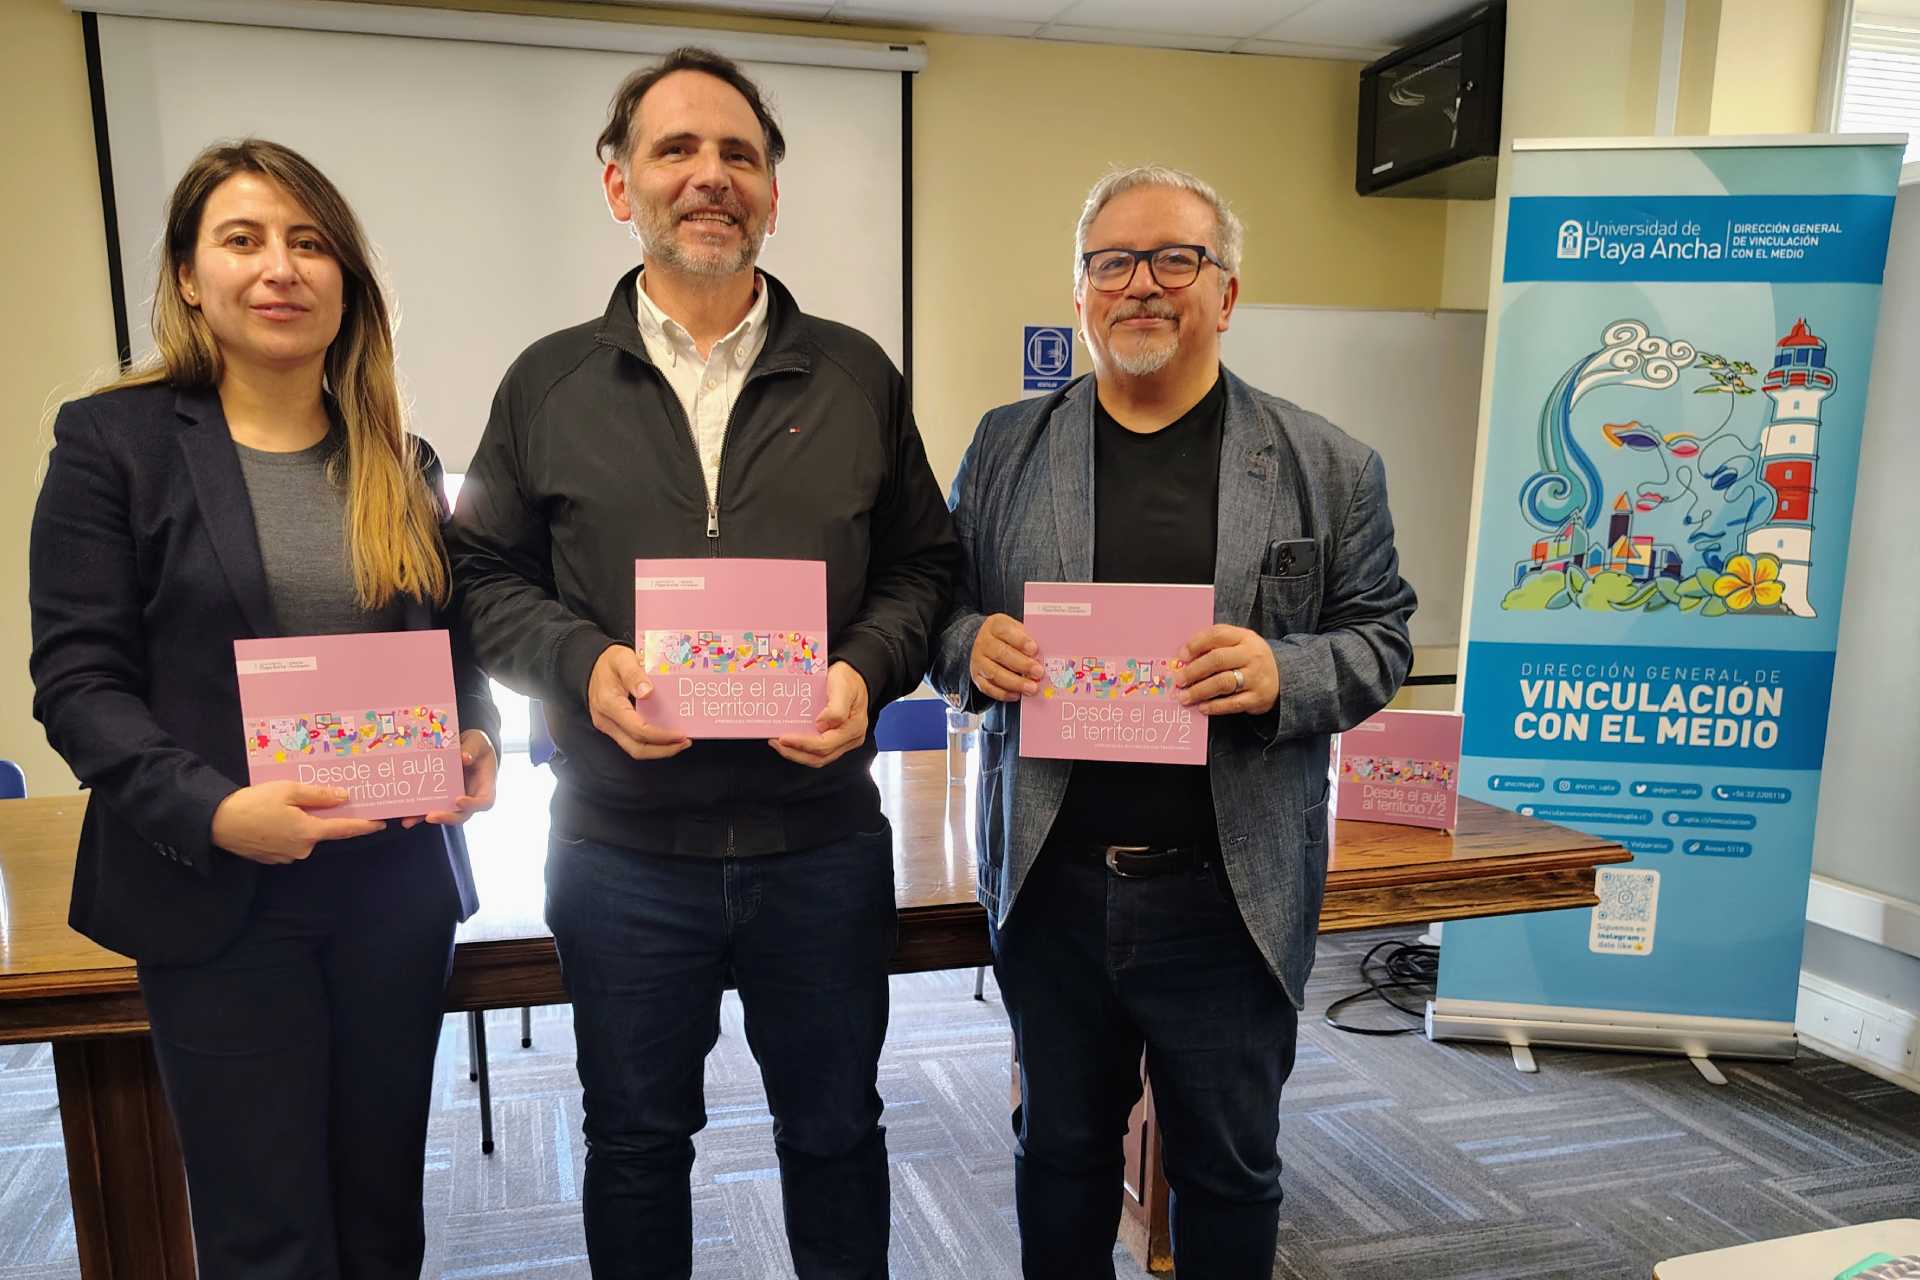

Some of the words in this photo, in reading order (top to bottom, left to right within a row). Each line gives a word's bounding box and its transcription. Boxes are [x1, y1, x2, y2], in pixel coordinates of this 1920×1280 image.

[1586, 220, 1678, 237] Universidad
[1681, 221, 1701, 237] de
[1733, 222, 1790, 235] DIRECCIÓN
[1791, 223, 1842, 234] GENERAL
[1583, 237, 1645, 265] Playa
[1649, 237, 1722, 260] Ancha
[1732, 236, 1747, 247] DE
[1748, 235, 1820, 247] VINCULACIÓN
[1731, 249, 1753, 259] CON
[1755, 249, 1768, 259] EL
[1770, 249, 1805, 259] MEDIO
[1520, 662, 1636, 679] DIRECCIÓN
[1646, 666, 1742, 682] GENERAL
[1754, 670, 1782, 684] DE
[679, 677, 744, 697] Desde
[750, 678, 766, 698] el
[772, 678, 812, 698] aula
[679, 698, 695, 717] al
[702, 699, 778, 718] territorio
[784, 699, 793, 716] /
[799, 699, 812, 717] 2
[1519, 679, 1784, 718] VINCULACIÓN
[1061, 702, 1123, 723] Desde
[1130, 704, 1146, 723] el
[1152, 704, 1192, 725] aula
[1061, 722, 1076, 740] al
[1081, 723, 1157, 743] territorio
[1162, 723, 1173, 743] /
[1178, 725, 1192, 744] 2
[1513, 711, 1590, 742] CON
[1599, 714, 1646, 744] EL
[1655, 715, 1779, 750] MEDIO
[299, 760, 370, 785] Desde
[378, 756, 395, 778] el
[402, 755, 446, 775] aula
[326, 776, 411, 800] rritorio
[417, 774, 426, 795] /
[433, 773, 447, 793] 2
[1363, 784, 1404, 800] Desde
[1408, 789, 1419, 801] el
[1423, 791, 1446, 804] aula
[1362, 798, 1374, 810] al
[1377, 799, 1425, 814] territorio
[1436, 804, 1447, 817] 2
